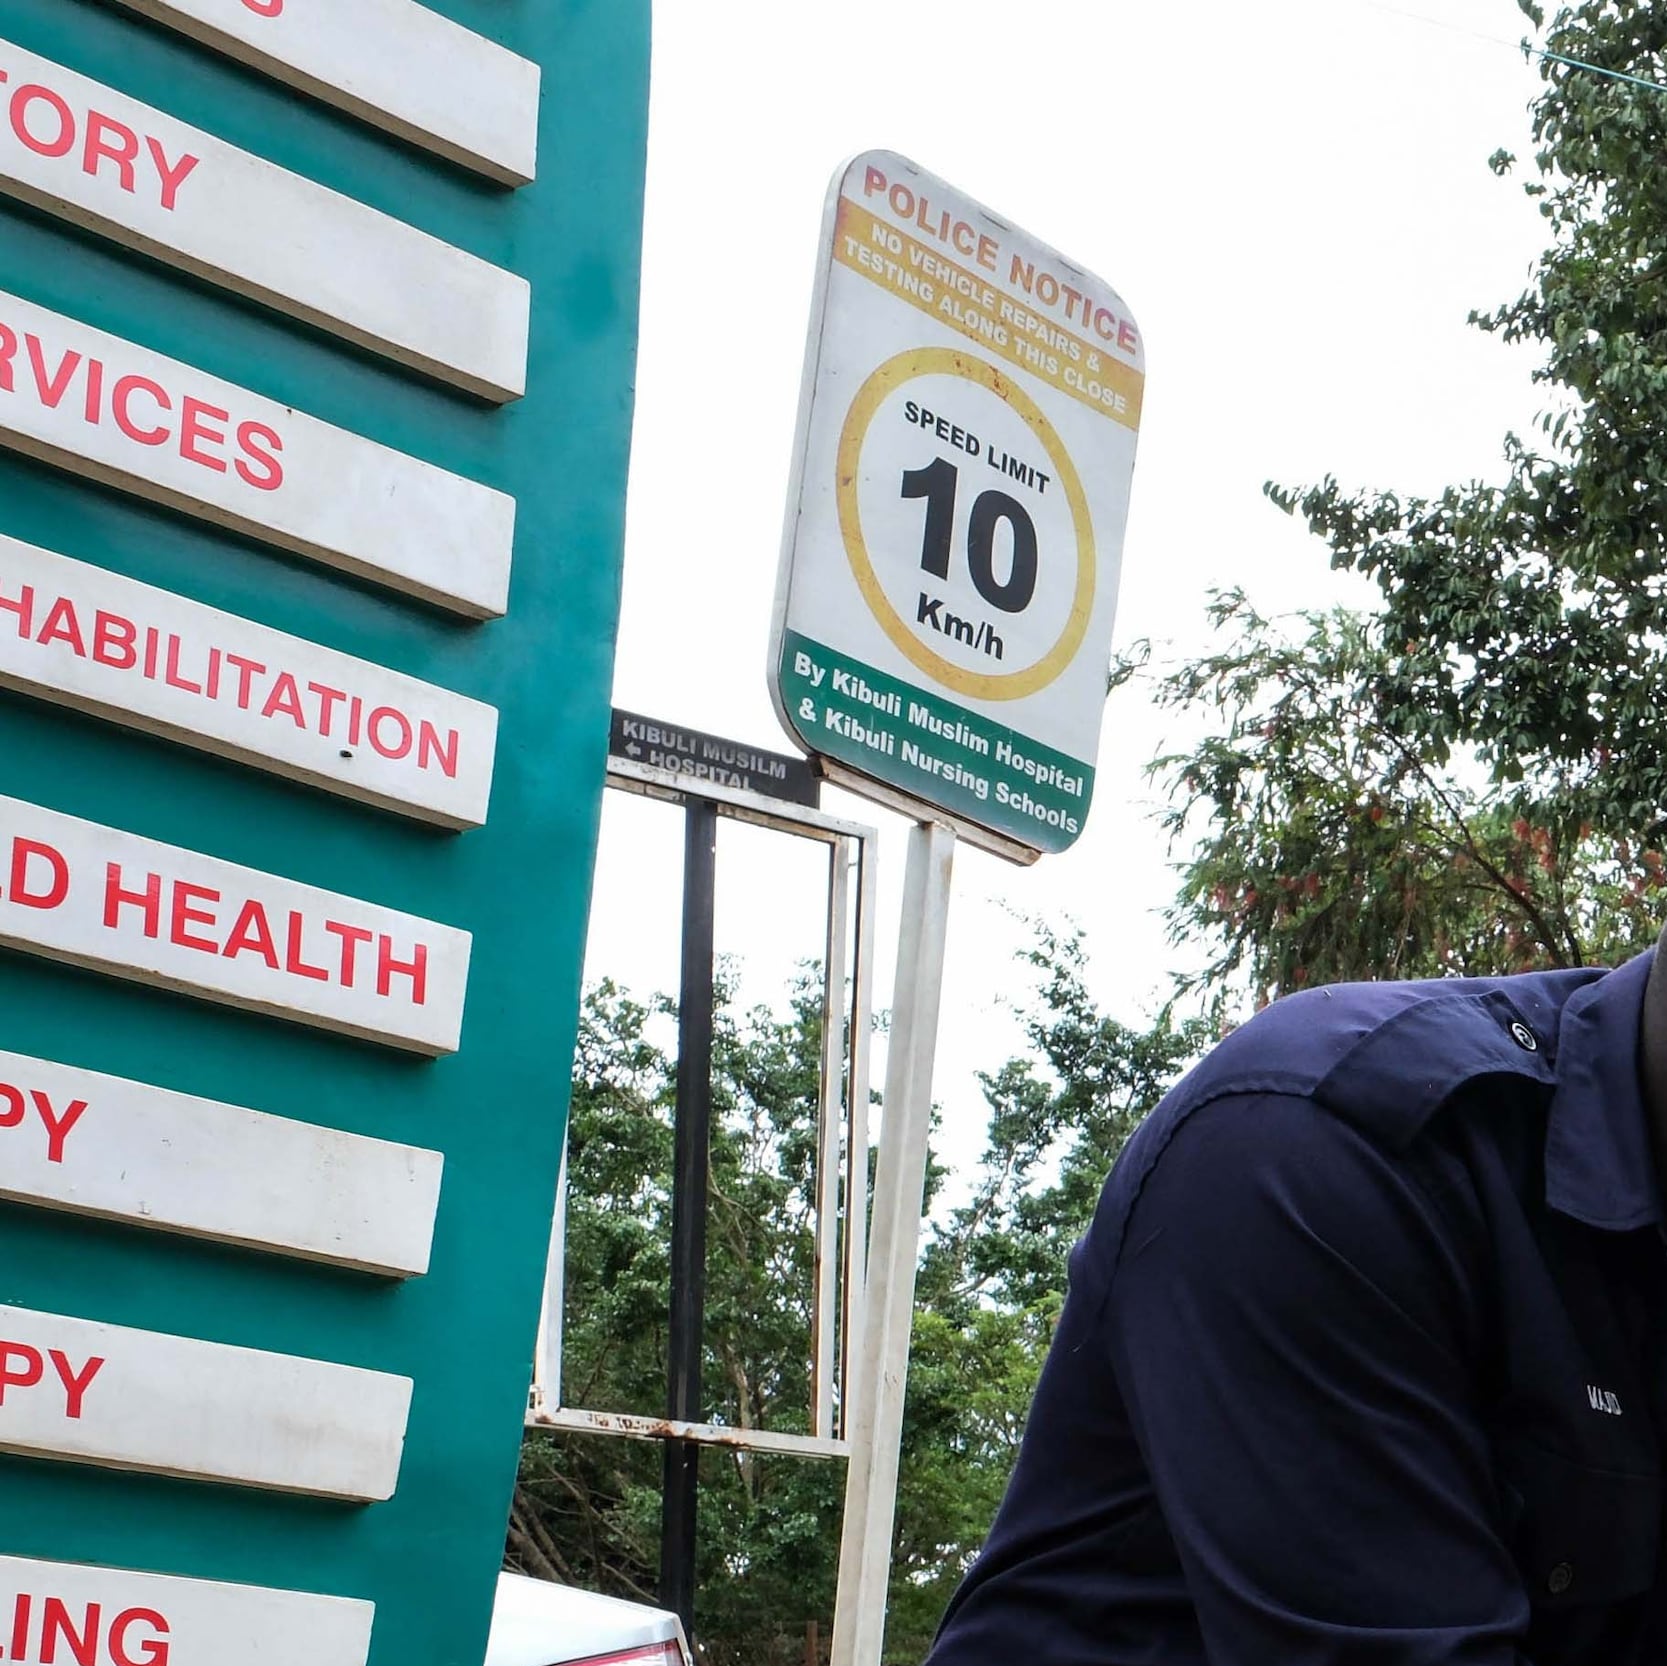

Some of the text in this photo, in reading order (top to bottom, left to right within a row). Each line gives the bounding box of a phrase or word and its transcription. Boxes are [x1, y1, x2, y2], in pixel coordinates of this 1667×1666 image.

[0, 69, 199, 210] ORY
[844, 236, 1127, 414] TESTING ALONG THIS CLOSE
[864, 165, 1138, 355] POLICE NOTICE
[872, 223, 1100, 373] NO VEHICLE REPAIRS &
[904, 401, 1050, 494] SPEED LIMIT
[901, 457, 1038, 613] 10
[917, 592, 1004, 661] Km/h
[622, 719, 697, 754] KIBULI
[795, 651, 1084, 797] By Kibuli Muslim Hospital
[799, 697, 1079, 835] & Kibuli Nursing Schools
[103, 863, 427, 1005] HEALTH
